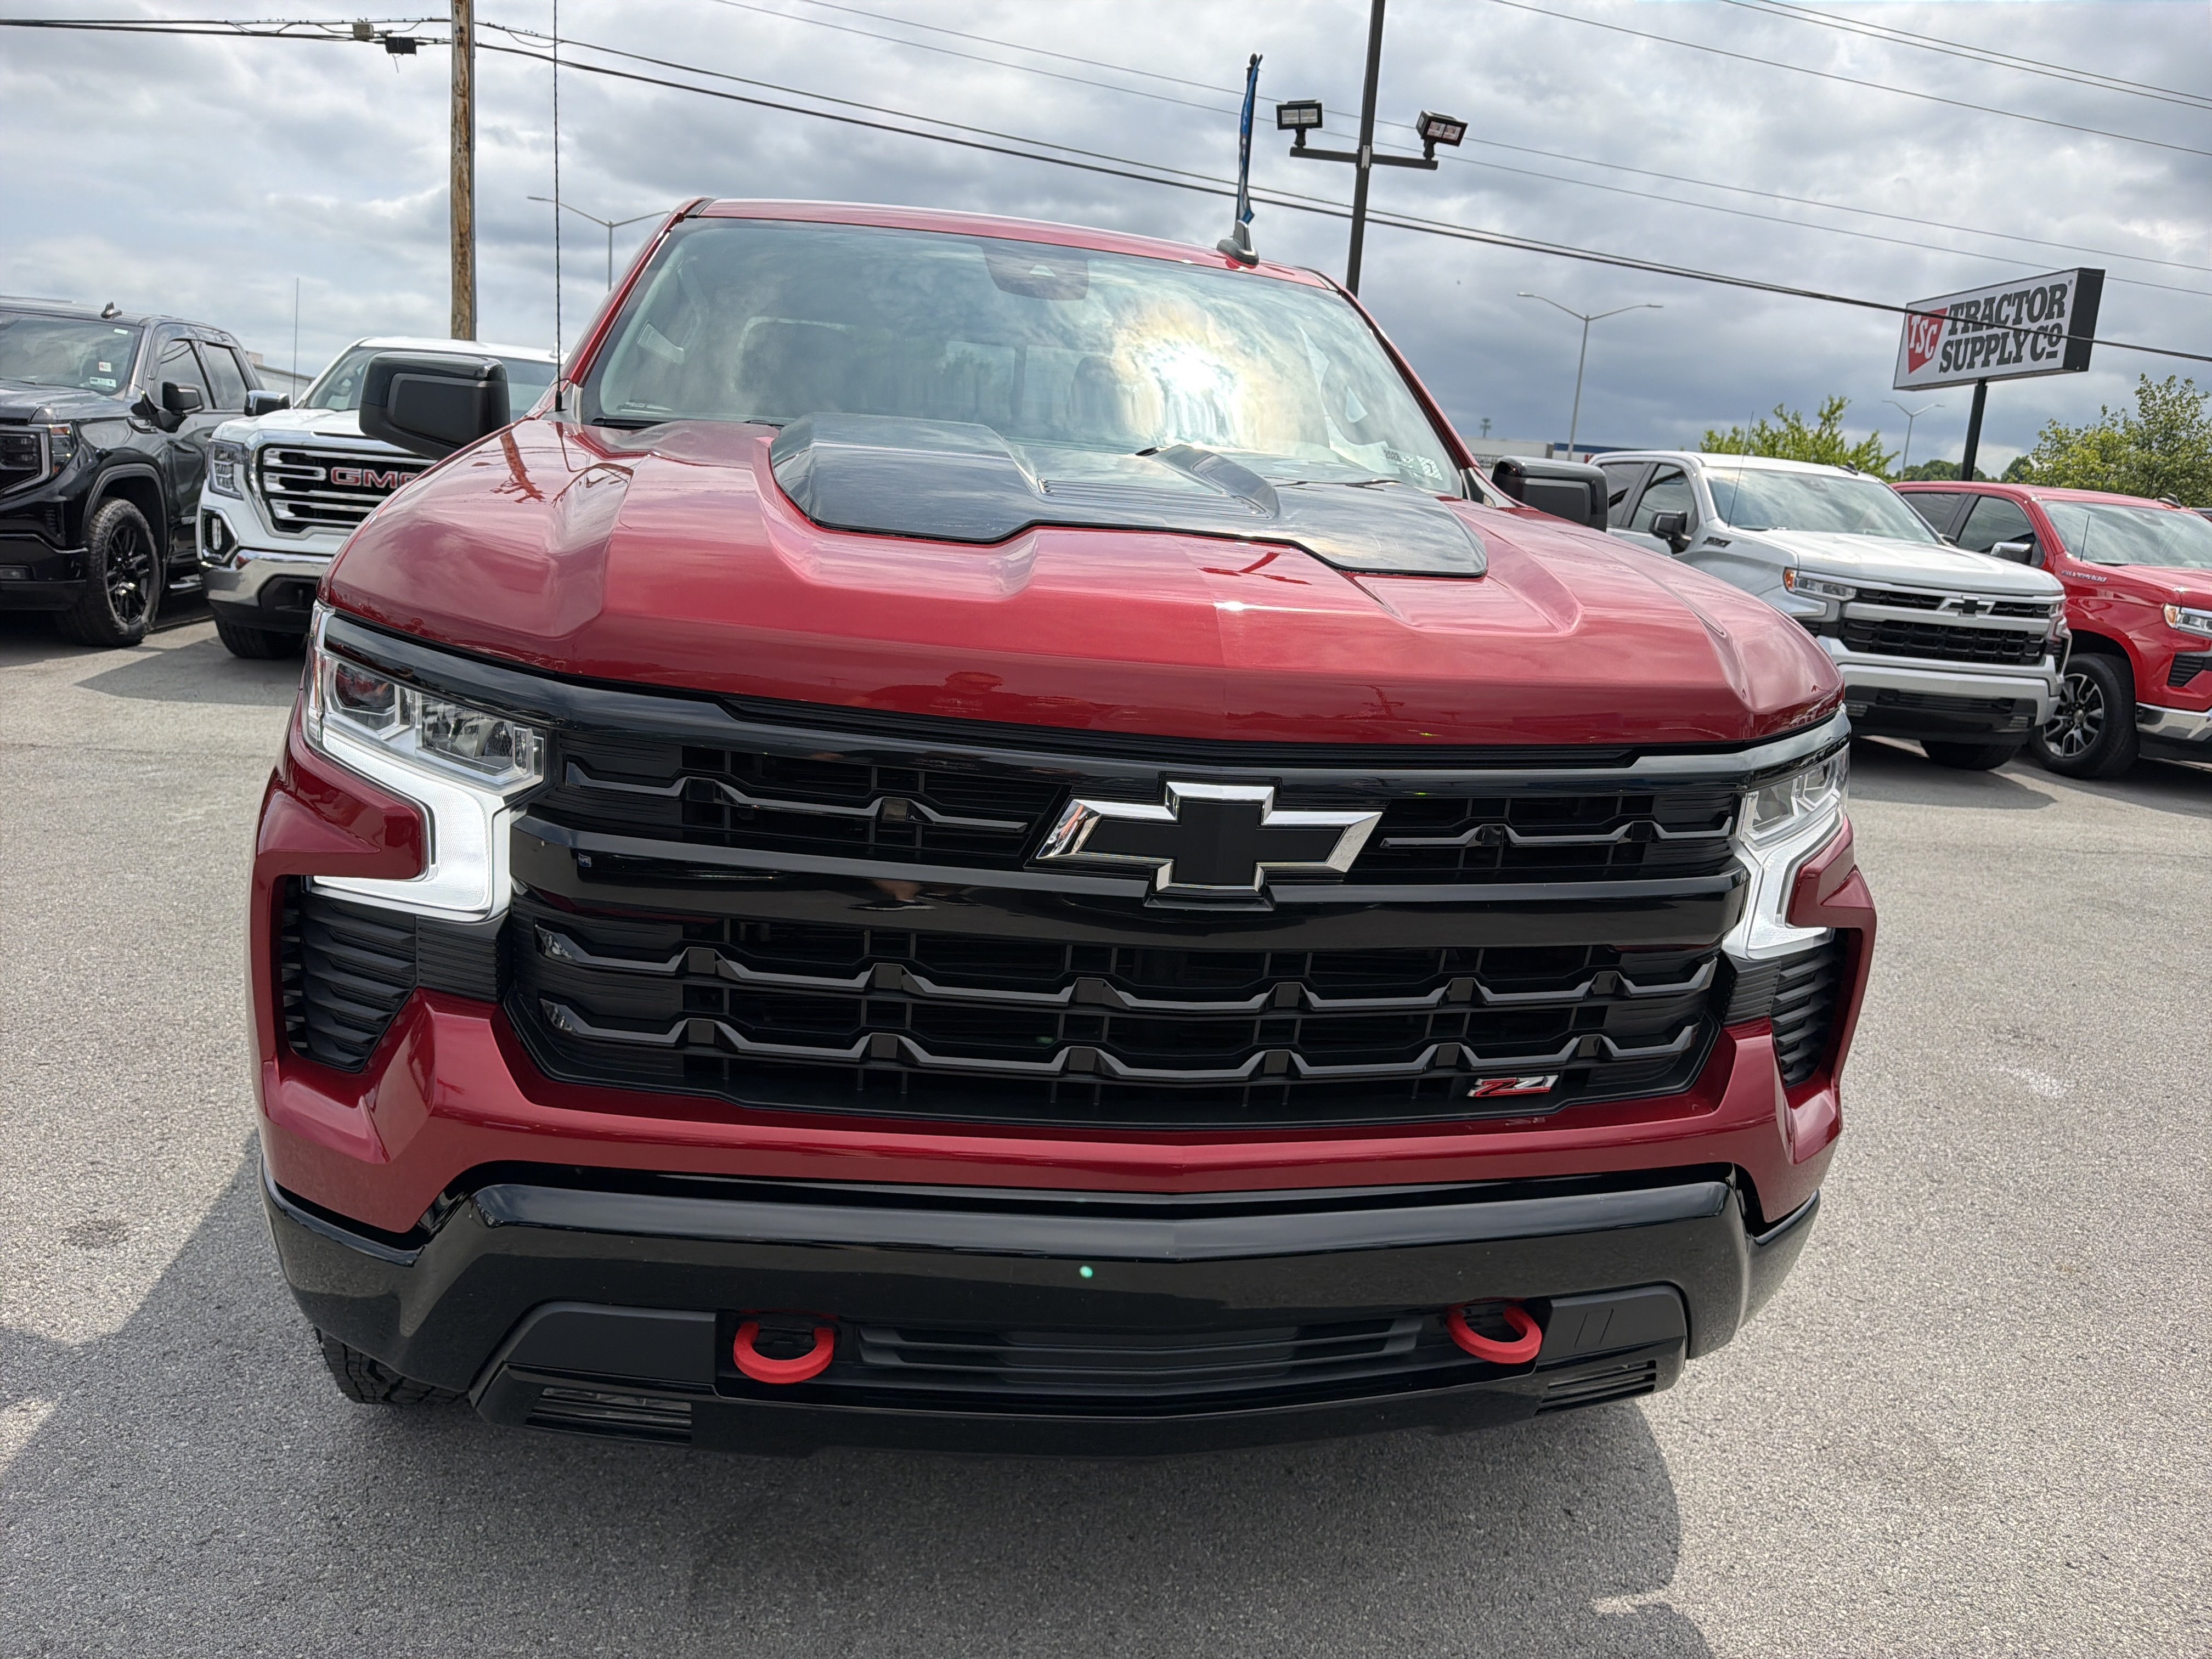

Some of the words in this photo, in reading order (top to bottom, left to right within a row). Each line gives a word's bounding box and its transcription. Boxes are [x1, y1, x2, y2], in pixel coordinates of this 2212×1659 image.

[1948, 283, 2068, 336] TRACTOR
[1909, 315, 1938, 359] TSC
[1938, 327, 2031, 374] SUPPLY
[1467, 1075, 1559, 1097] Z71
